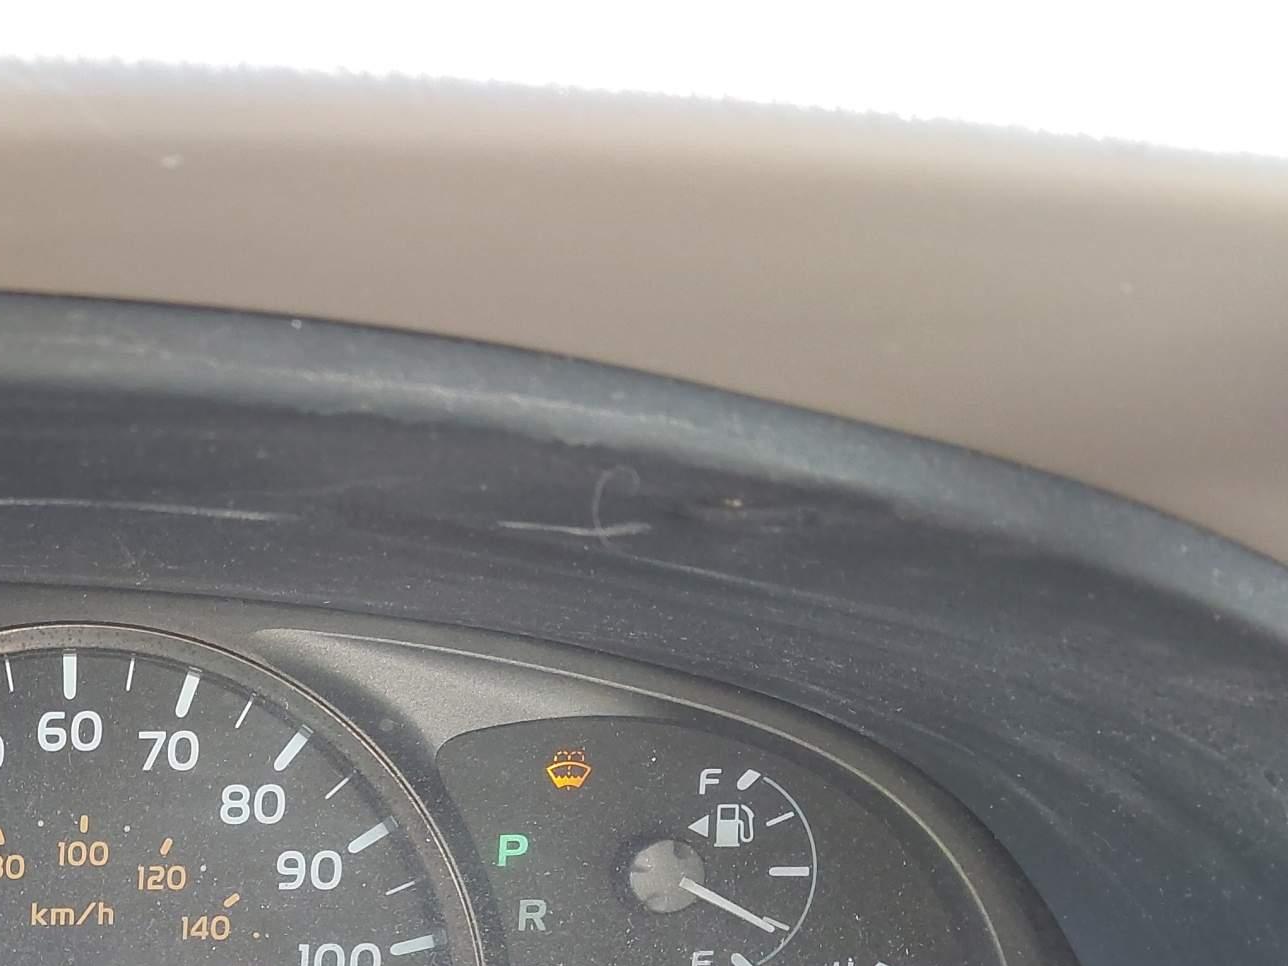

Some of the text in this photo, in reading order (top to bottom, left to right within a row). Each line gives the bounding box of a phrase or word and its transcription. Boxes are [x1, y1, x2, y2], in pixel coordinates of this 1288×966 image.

[37, 711, 103, 752] 60
[138, 730, 200, 771] 70
[698, 769, 721, 794] F
[220, 785, 286, 824] 80
[57, 842, 108, 867] 100
[497, 834, 529, 866] P
[137, 865, 187, 890] 120
[276, 850, 343, 891] 90
[31, 901, 115, 927] km/h
[181, 915, 231, 940] 140
[517, 899, 546, 931] R
